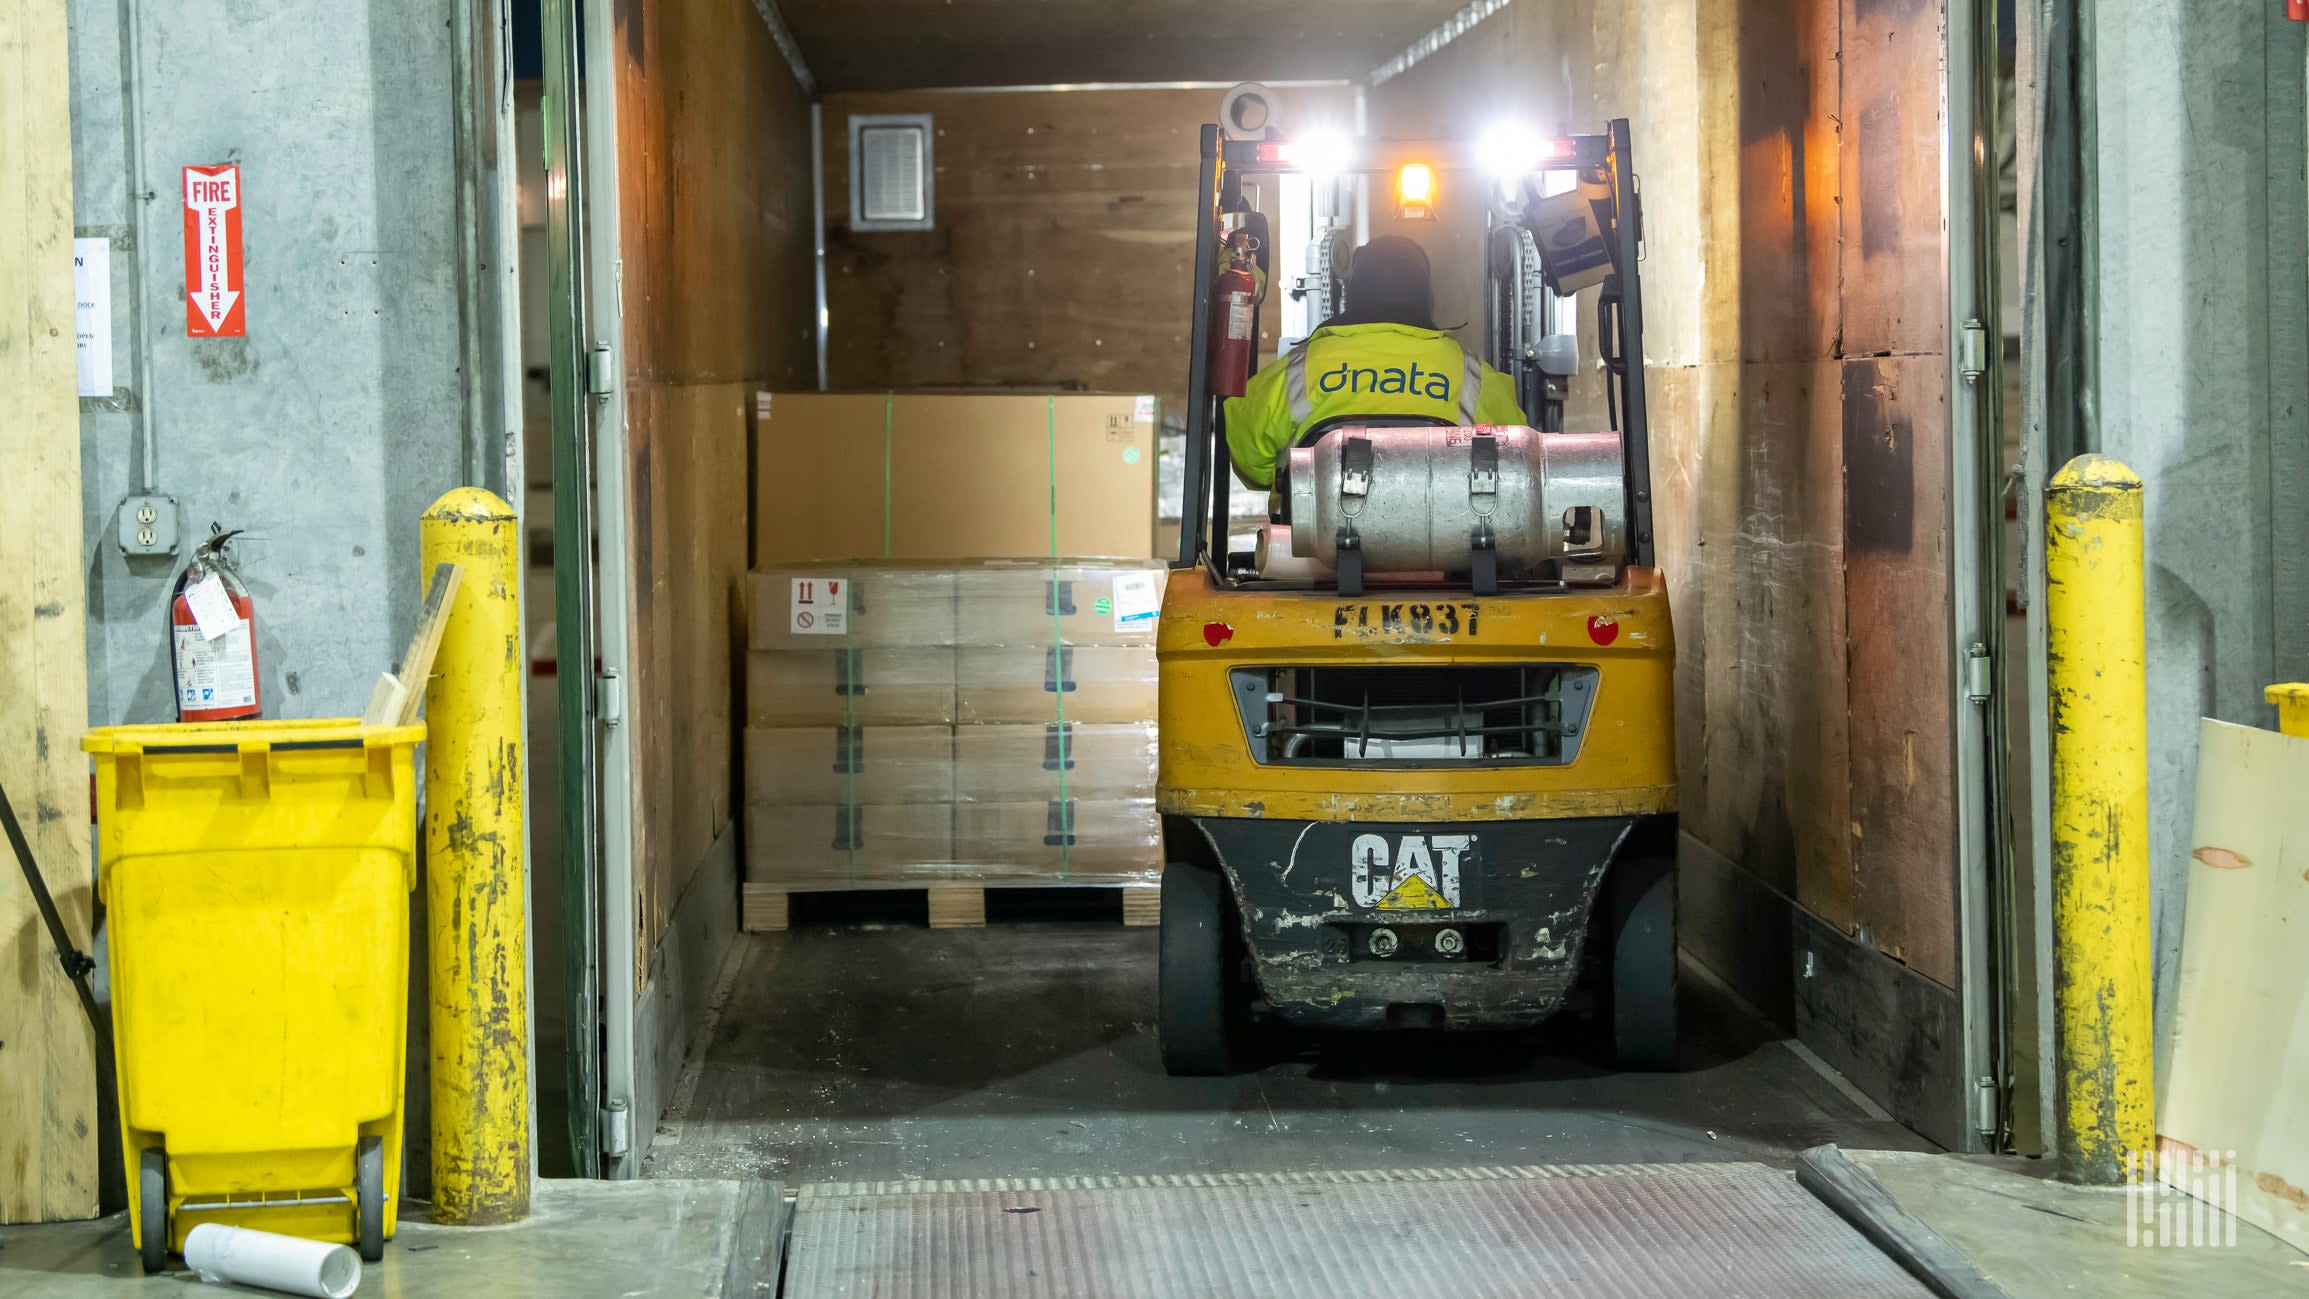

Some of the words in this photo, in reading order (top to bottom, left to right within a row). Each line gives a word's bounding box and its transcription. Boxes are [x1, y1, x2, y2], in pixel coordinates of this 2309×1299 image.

[193, 181, 231, 202] FIRE
[208, 208, 221, 319] EXTINGUISHER
[1319, 362, 1450, 402] dnata
[1334, 604, 1480, 639] FLK837
[1352, 834, 1470, 908] CAT
